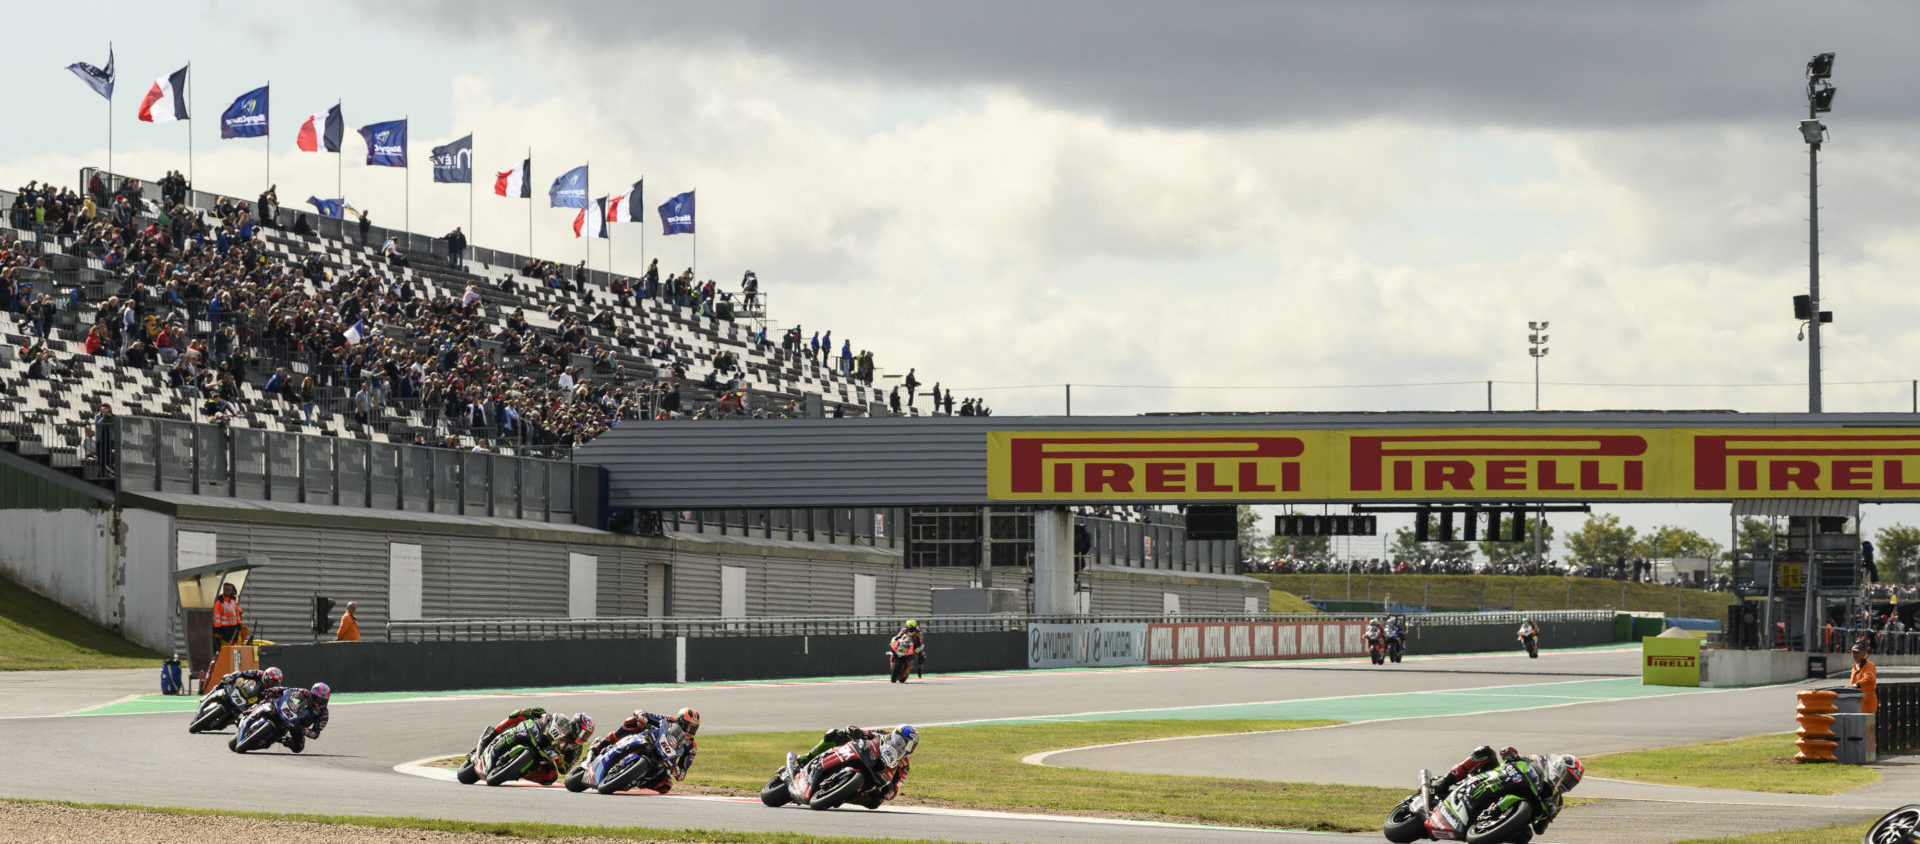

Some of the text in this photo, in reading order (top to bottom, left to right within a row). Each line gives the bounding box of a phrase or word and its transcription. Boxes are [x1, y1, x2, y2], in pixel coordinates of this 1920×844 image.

[1011, 437, 1305, 493] PIRELLI
[1350, 435, 1647, 491] PIRELLI
[1694, 435, 1920, 490] PIREL
[1042, 631, 1074, 659] HYUNDAI
[1103, 631, 1132, 657] HYUNDAI
[1150, 626, 1174, 660] MOTUL
[1177, 626, 1200, 659] MOTUL
[1203, 625, 1226, 658] MOTUL
[1229, 625, 1251, 657] MOTUL
[1254, 625, 1275, 656] MOTUL
[1278, 625, 1297, 656] MOTUL
[1647, 656, 1695, 667] PIRELLI
[660, 741, 672, 754] 60
